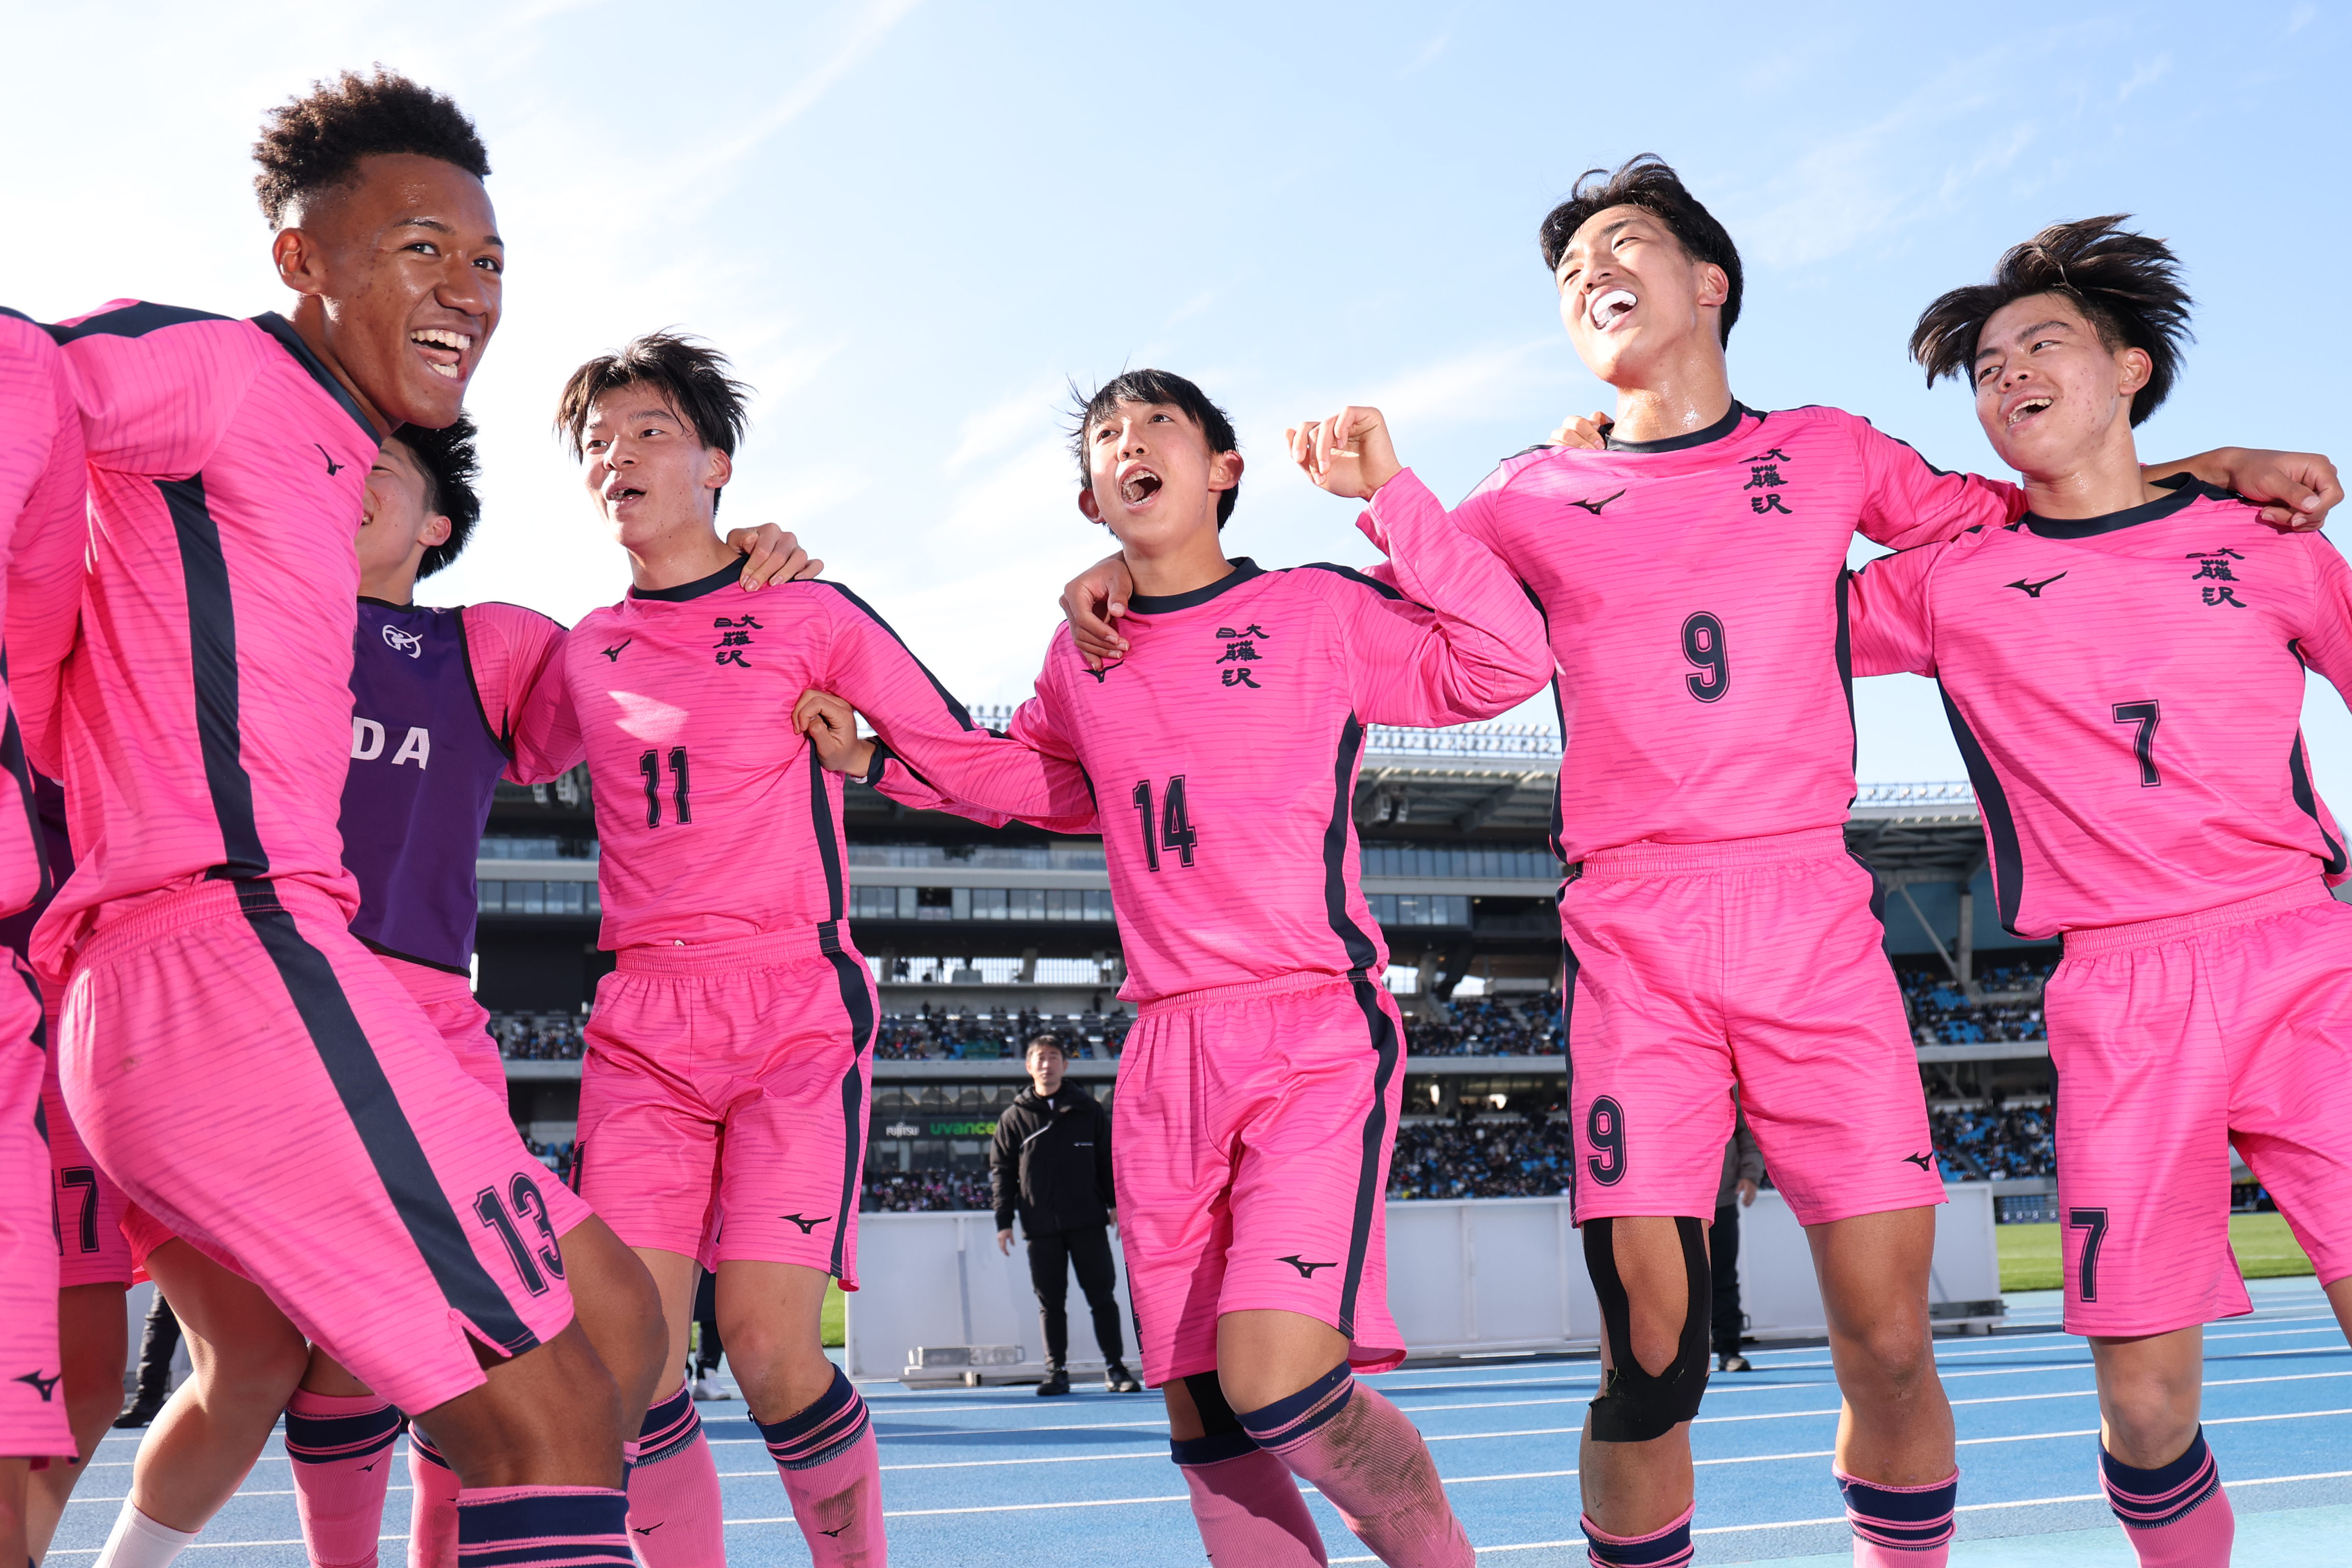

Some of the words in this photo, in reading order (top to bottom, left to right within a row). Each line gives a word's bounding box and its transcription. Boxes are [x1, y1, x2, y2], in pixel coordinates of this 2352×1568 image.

[1681, 611, 1730, 703] 9
[639, 746, 691, 829] 11
[2112, 699, 2161, 788] 7
[1132, 775, 1198, 872] 14
[1587, 1095, 1627, 1187] 9
[472, 1172, 565, 1298] 13
[2069, 1207, 2109, 1303] 7
